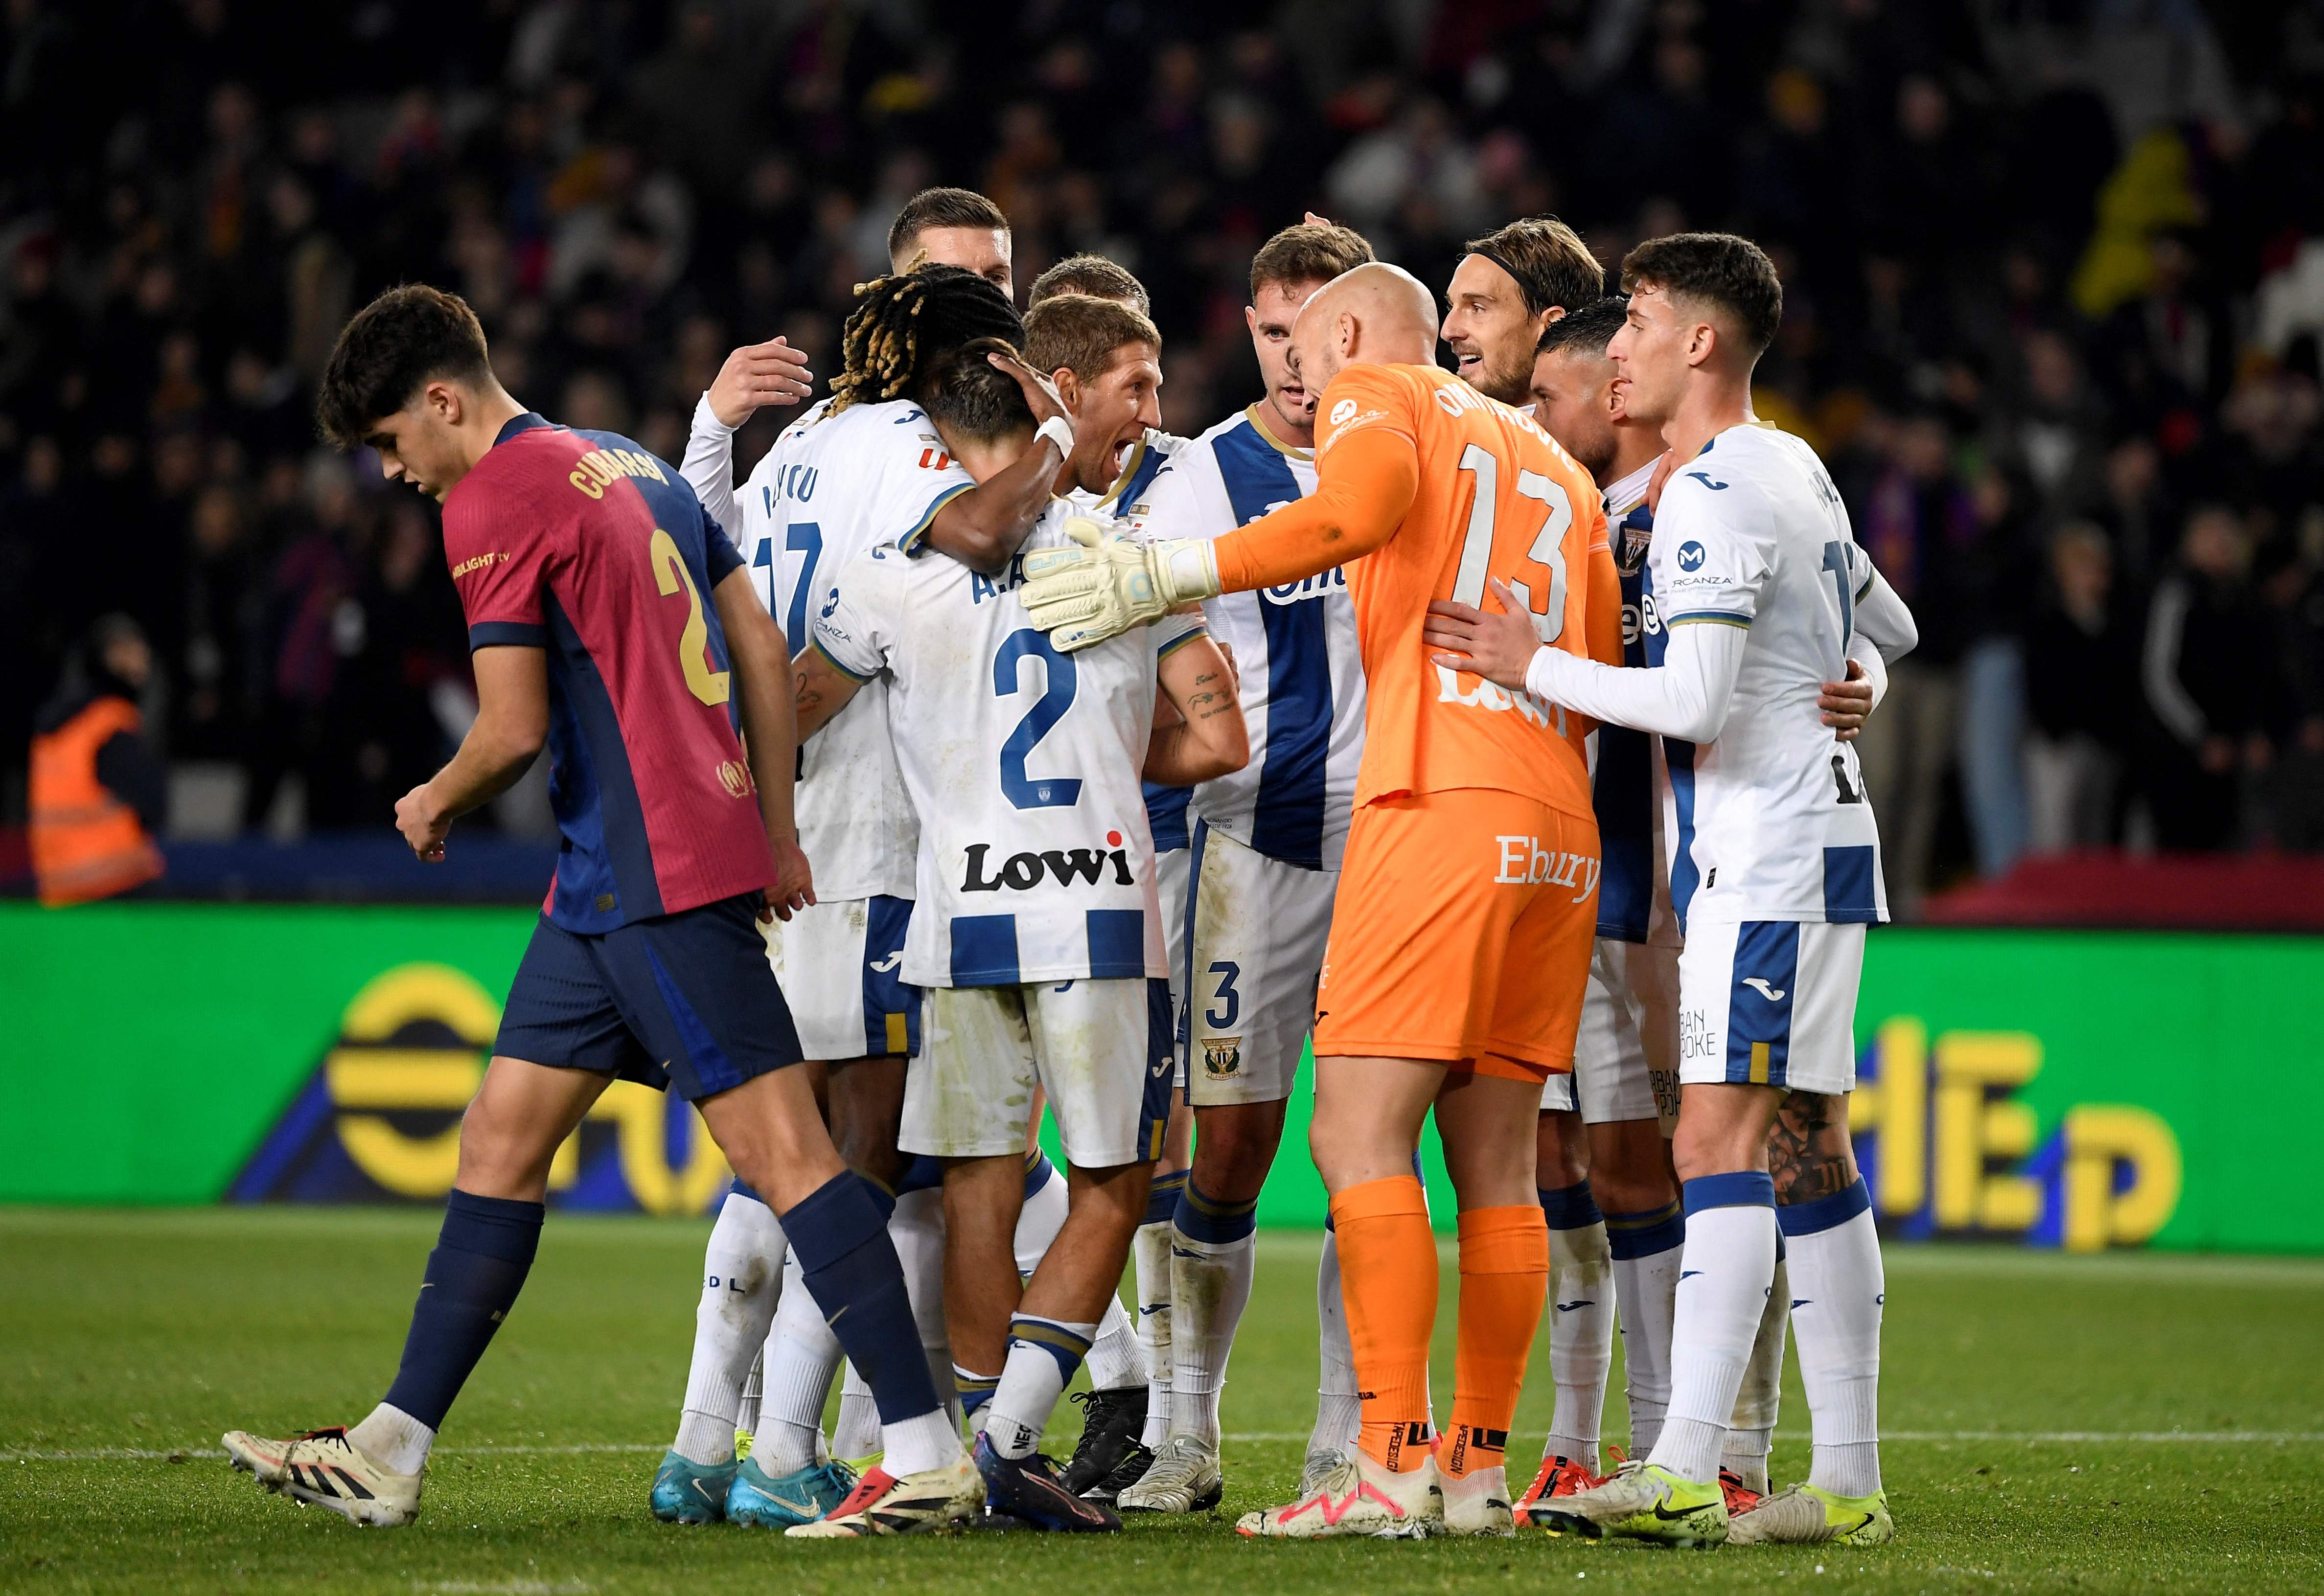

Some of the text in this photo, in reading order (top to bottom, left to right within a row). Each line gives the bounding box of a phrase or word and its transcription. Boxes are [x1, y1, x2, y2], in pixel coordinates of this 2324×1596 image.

[498, 553, 510, 562] tv
[1452, 443, 1573, 643] 13
[753, 522, 823, 660] 17
[1672, 576, 1732, 588] RCANZA
[650, 528, 730, 707] 2
[993, 628, 1082, 810] 2
[960, 830, 1134, 892] Lowi
[1494, 836, 1601, 903] Ebury
[1205, 961, 1241, 1029] 3
